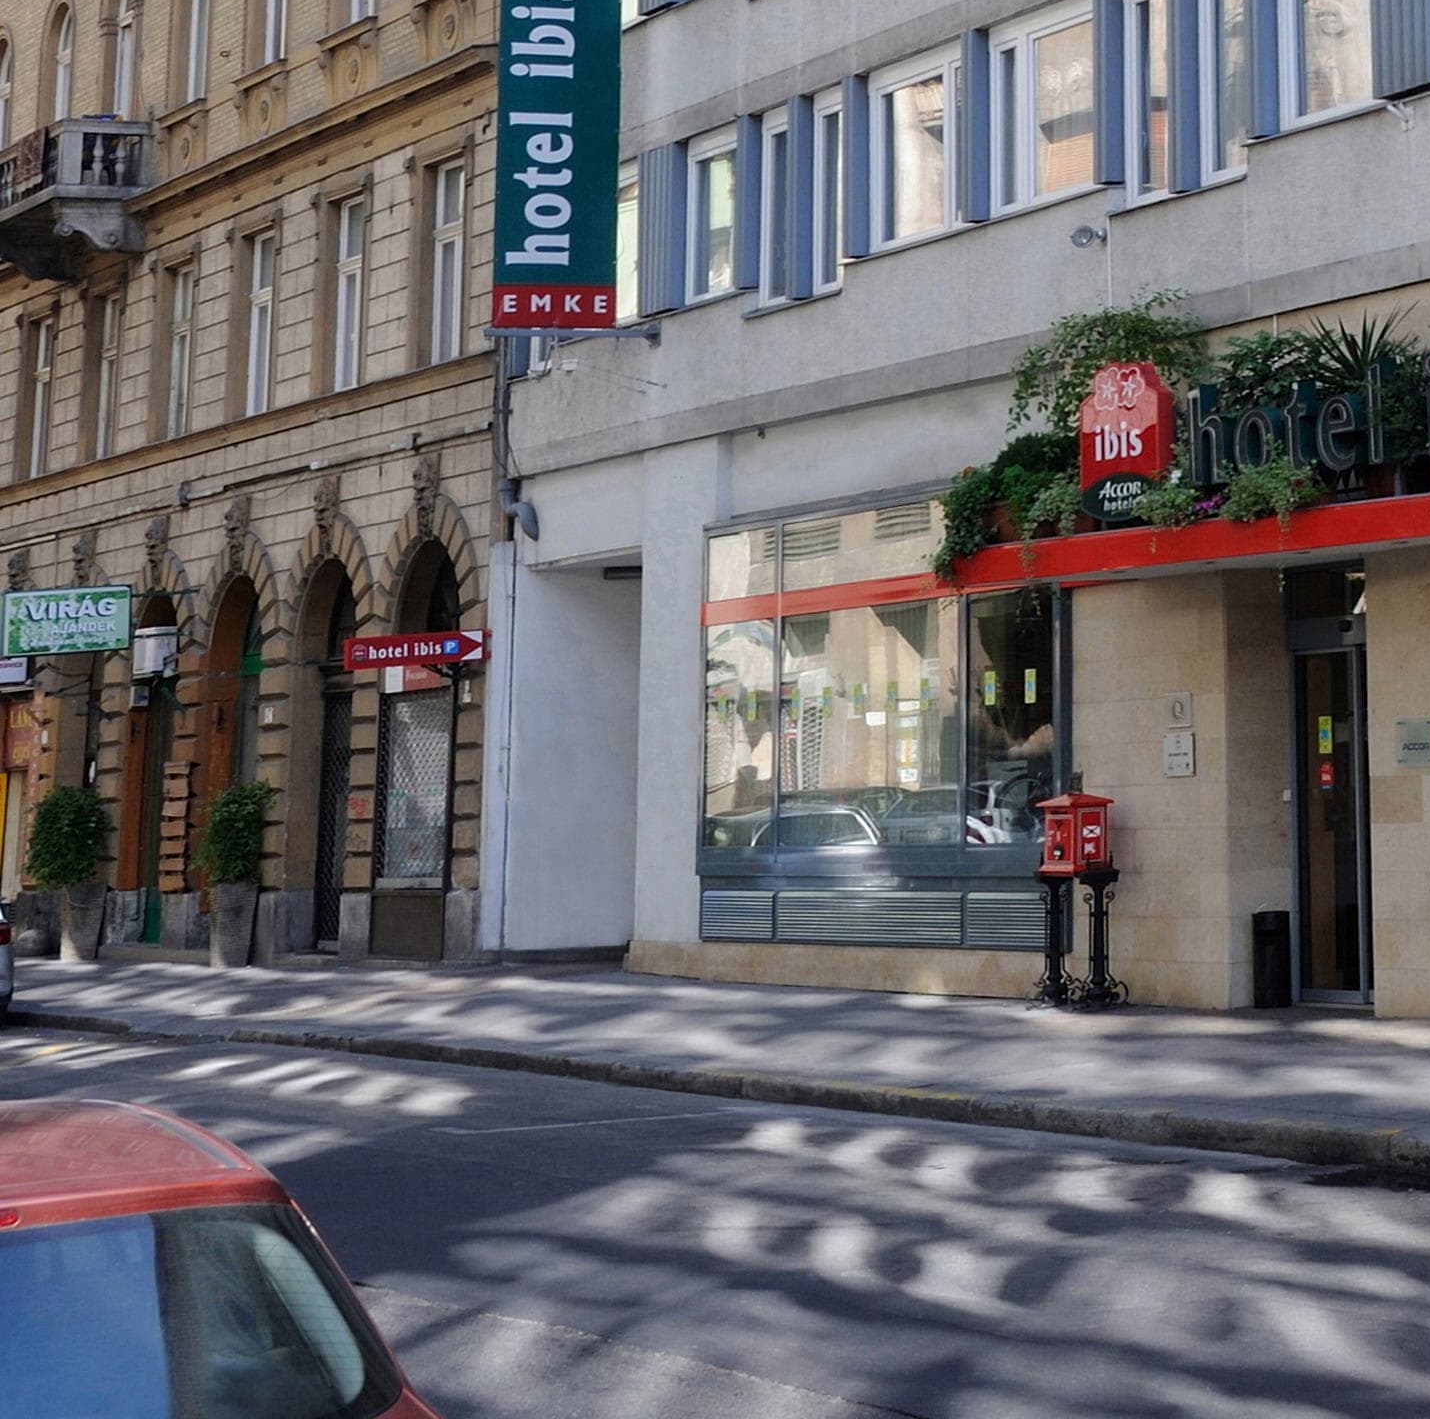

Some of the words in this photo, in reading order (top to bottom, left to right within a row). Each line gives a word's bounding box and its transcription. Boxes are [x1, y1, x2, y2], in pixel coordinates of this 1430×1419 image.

[505, 112, 573, 266] hotel
[502, 294, 608, 314] EMKE
[1187, 362, 1383, 485] hotel
[1094, 420, 1143, 463] ibis
[1098, 480, 1142, 500] ACCOR
[25, 595, 118, 622] VIRÁG
[368, 642, 408, 660] hotel
[414, 640, 442, 656] ibis
